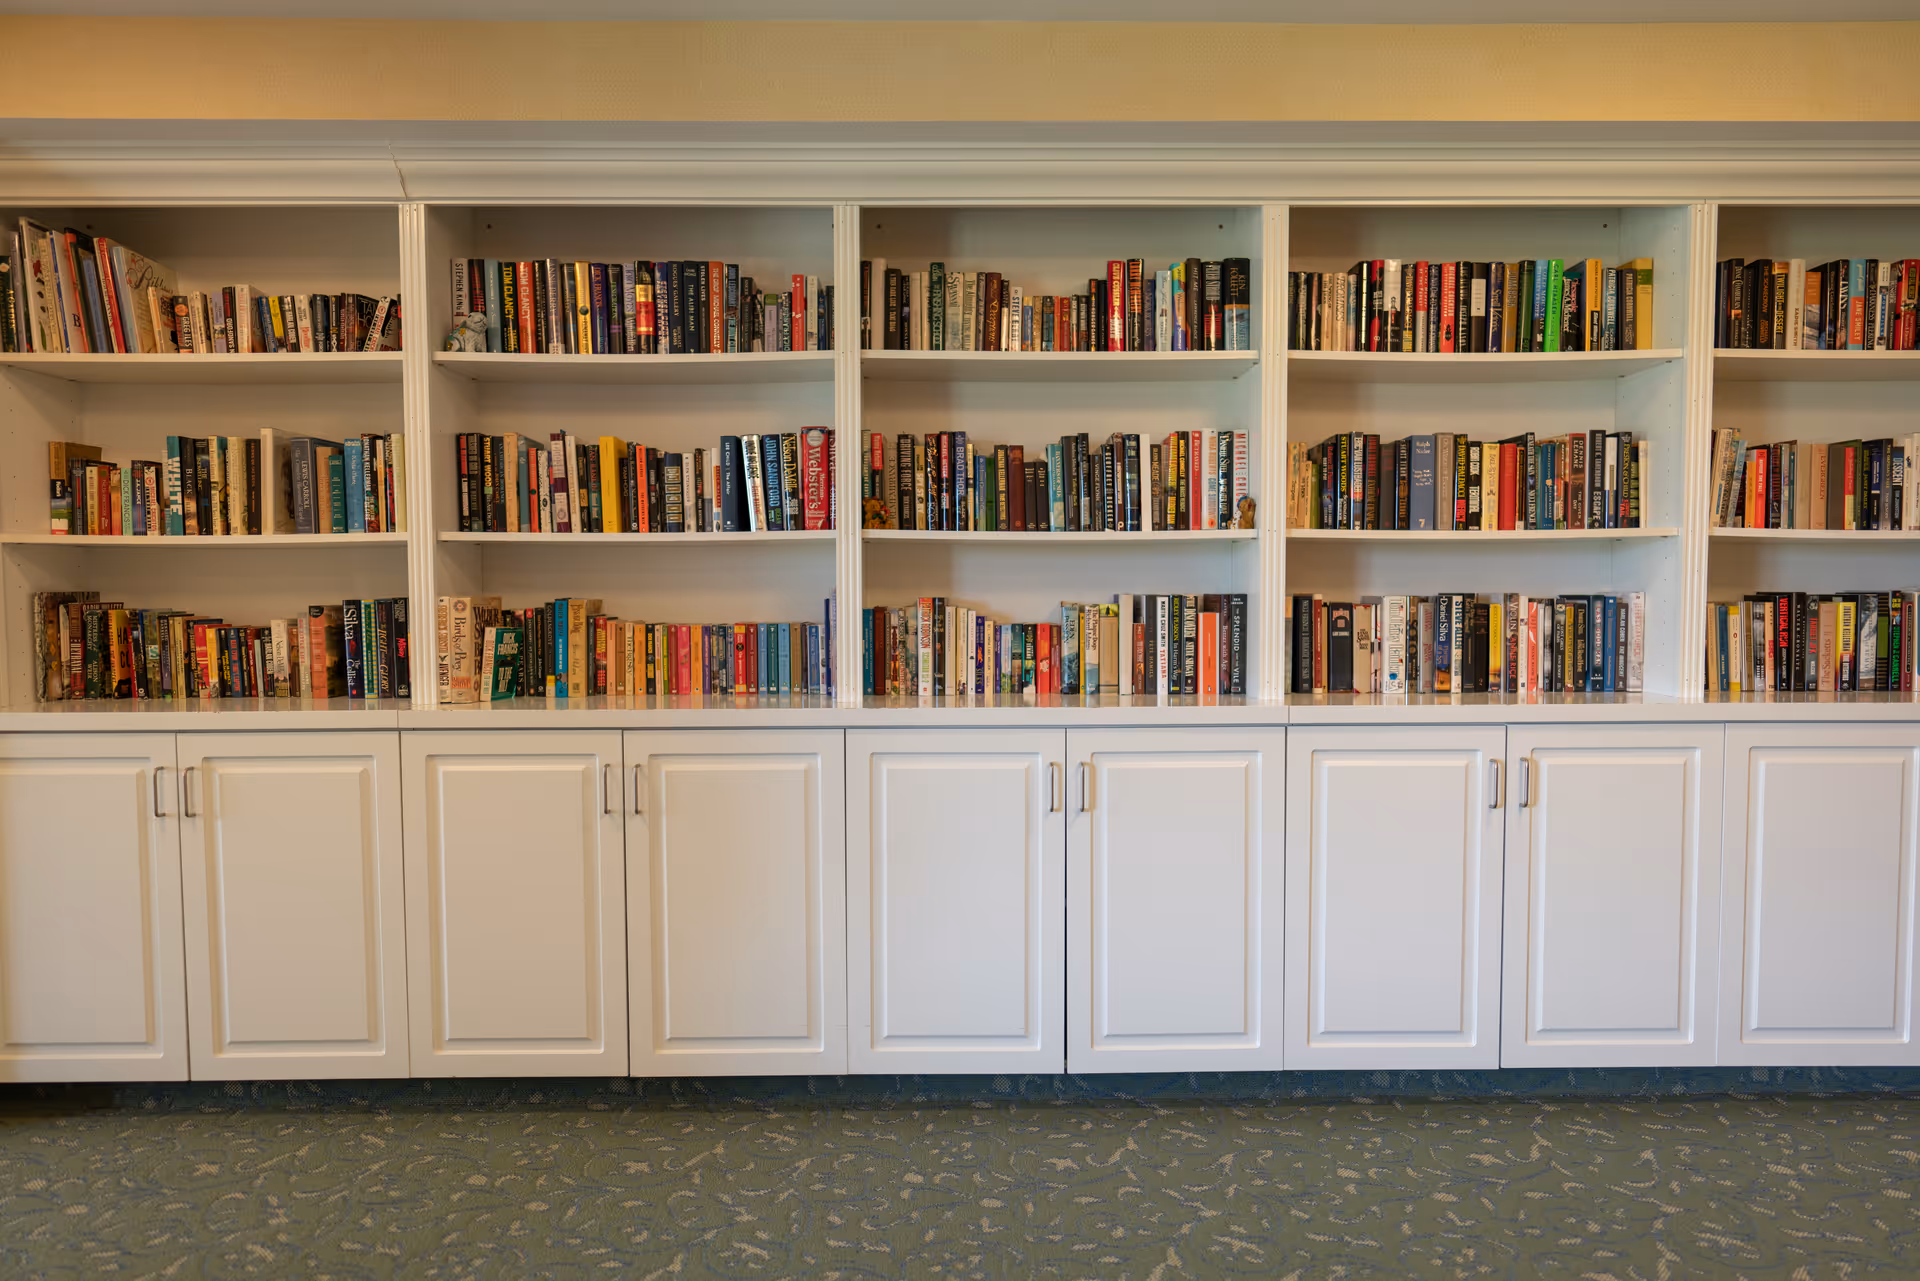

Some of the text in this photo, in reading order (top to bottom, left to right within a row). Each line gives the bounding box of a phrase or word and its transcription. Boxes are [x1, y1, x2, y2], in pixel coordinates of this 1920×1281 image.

[519, 267, 528, 284] TOM
[1112, 263, 1120, 279] CLIVE
[1230, 267, 1238, 297] FOLLETT
[1607, 269, 1616, 294] PATRICIA
[455, 263, 464, 310] STEPHEN KING
[504, 266, 514, 319] TOM CLANCY
[1193, 281, 1198, 291] ME
[1776, 274, 1785, 303] TWILIGHT
[521, 286, 530, 320] CLANCY
[1012, 296, 1020, 317] STEVE
[182, 317, 191, 330] GREG
[782, 436, 797, 492] Nelson DeMille
[900, 438, 911, 468] DRIVING
[1235, 433, 1246, 497] MICHAEL CRIC
[765, 437, 780, 506] JOHN SANDFORD
[808, 447, 821, 509] Webster's
[901, 470, 912, 490] FORCE
[957, 447, 965, 495] BRAD THOR
[1151, 462, 1159, 481] MEADE
[1457, 445, 1465, 497] DAVID BALDACCI
[1893, 458, 1902, 486] DESCENT
[168, 457, 182, 516] WHITE
[1593, 491, 1601, 520] ESCAPE
[344, 608, 357, 640] Silva
[1439, 598, 1448, 641] Daniel Silva
[1455, 601, 1463, 625] STEVE
[1779, 598, 1788, 631] VERTICAL
[453, 617, 467, 642] Birds
[453, 652, 467, 671] Prey
[1809, 642, 1817, 654] JFK
[1509, 662, 1517, 679] RICE
